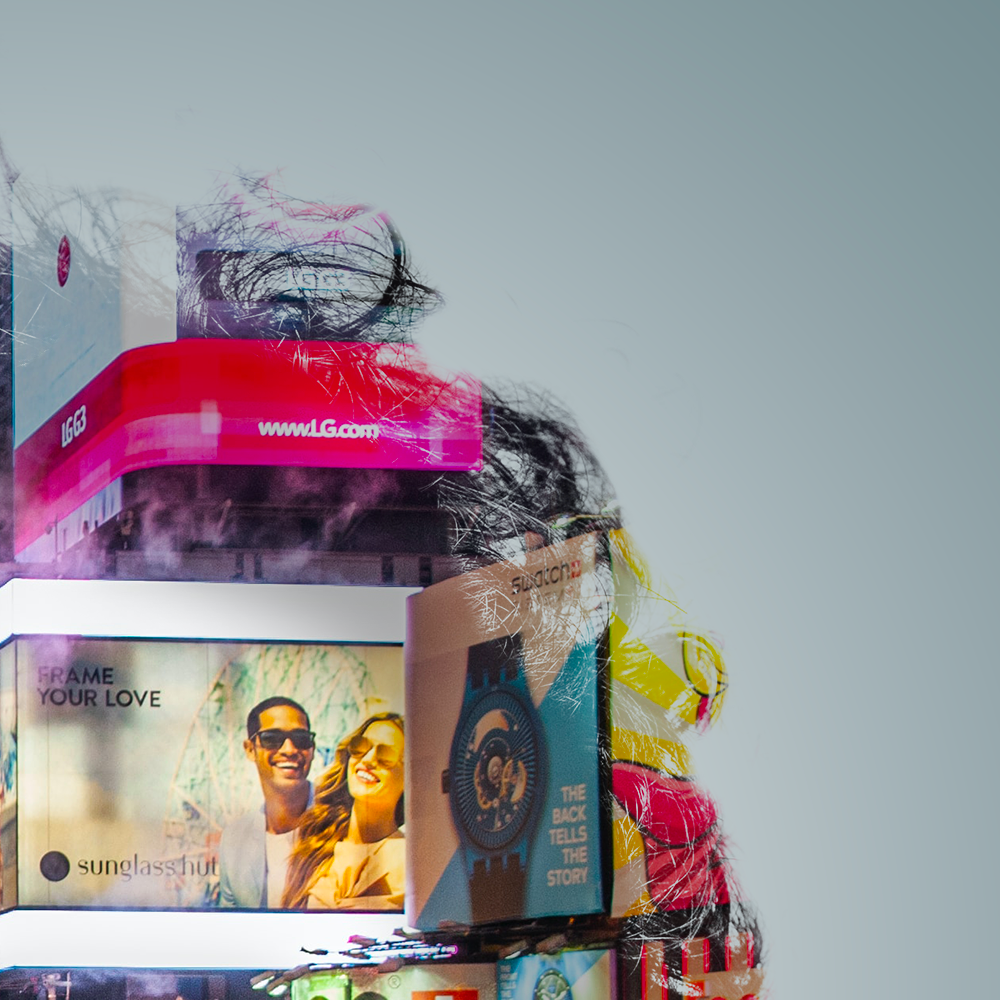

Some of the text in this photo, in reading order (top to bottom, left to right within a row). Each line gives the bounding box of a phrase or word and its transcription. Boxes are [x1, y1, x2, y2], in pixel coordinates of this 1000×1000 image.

[258, 418, 380, 439] www.LG.com
[37, 667, 114, 685] FRAME
[37, 688, 161, 708] YOUR LOVE
[561, 784, 586, 801] THE
[552, 804, 587, 823] BACK
[549, 827, 588, 842] TELLS
[563, 847, 588, 863] THE
[78, 853, 219, 882] sunglass hut
[547, 867, 588, 887] STORY
